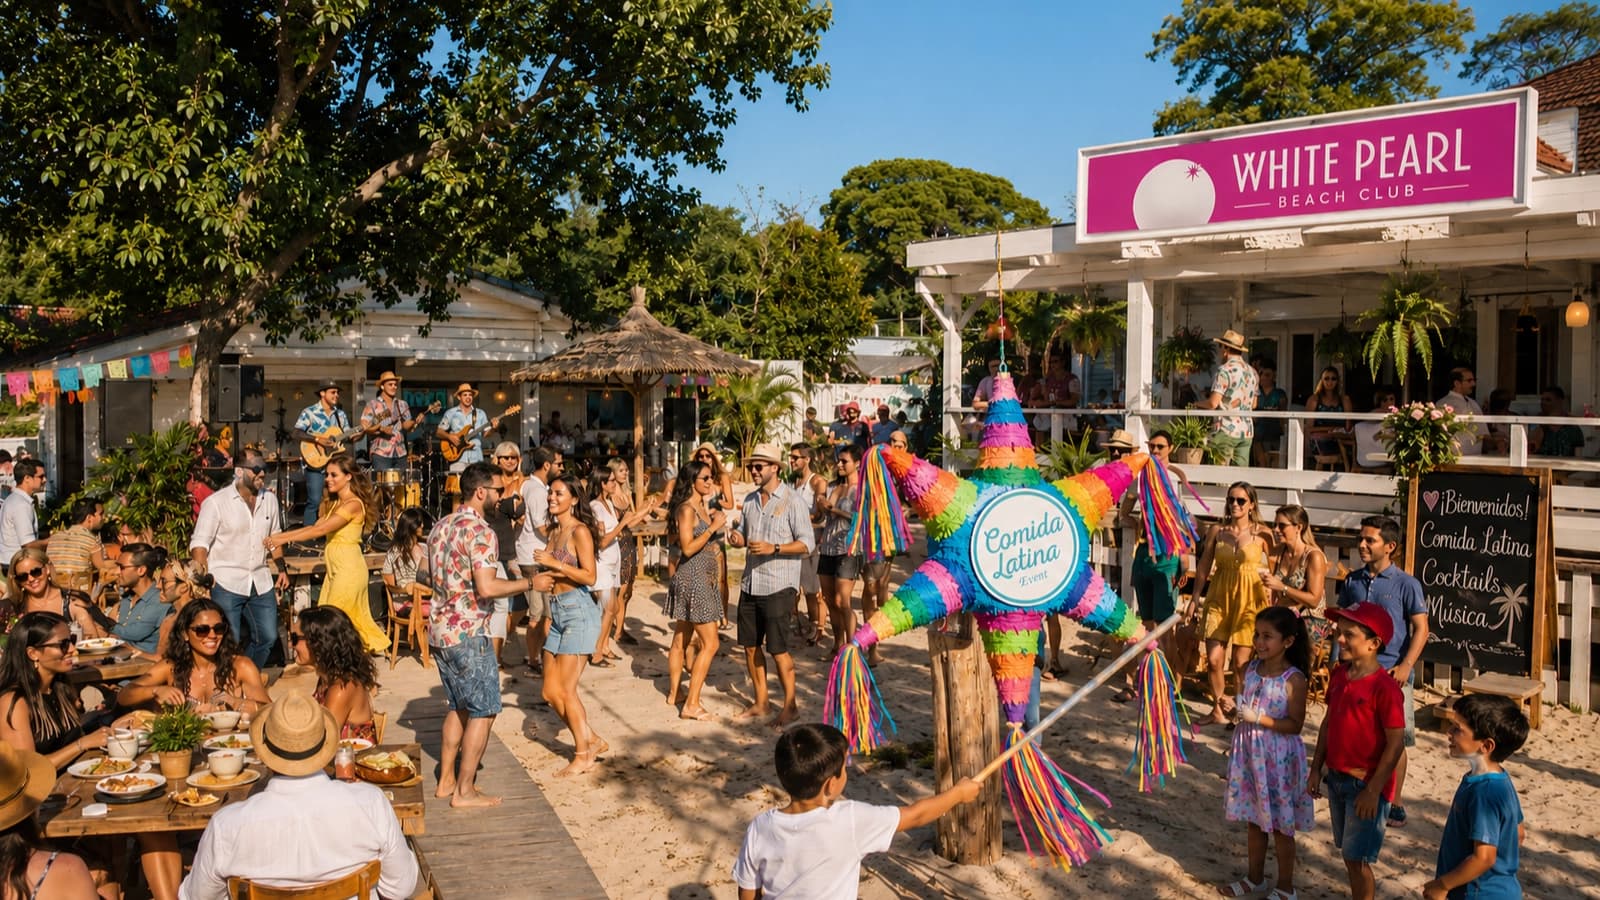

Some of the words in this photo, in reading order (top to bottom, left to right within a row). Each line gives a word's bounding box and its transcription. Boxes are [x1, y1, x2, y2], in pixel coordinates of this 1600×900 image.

[1233, 142, 1339, 194] WHITE
[1355, 128, 1471, 181] PEARL
[1278, 190, 1346, 209] BEACH
[1360, 183, 1415, 201] CLUB
[1440, 489, 1530, 520] ¡Bienvenidos!
[984, 512, 1064, 554] Comida
[1420, 520, 1477, 552] Comida
[1480, 525, 1532, 559] Latina
[993, 544, 1060, 579] Latina
[1019, 570, 1048, 586] Event
[1422, 557, 1501, 594] Cocktails
[1426, 594, 1488, 629] Música
